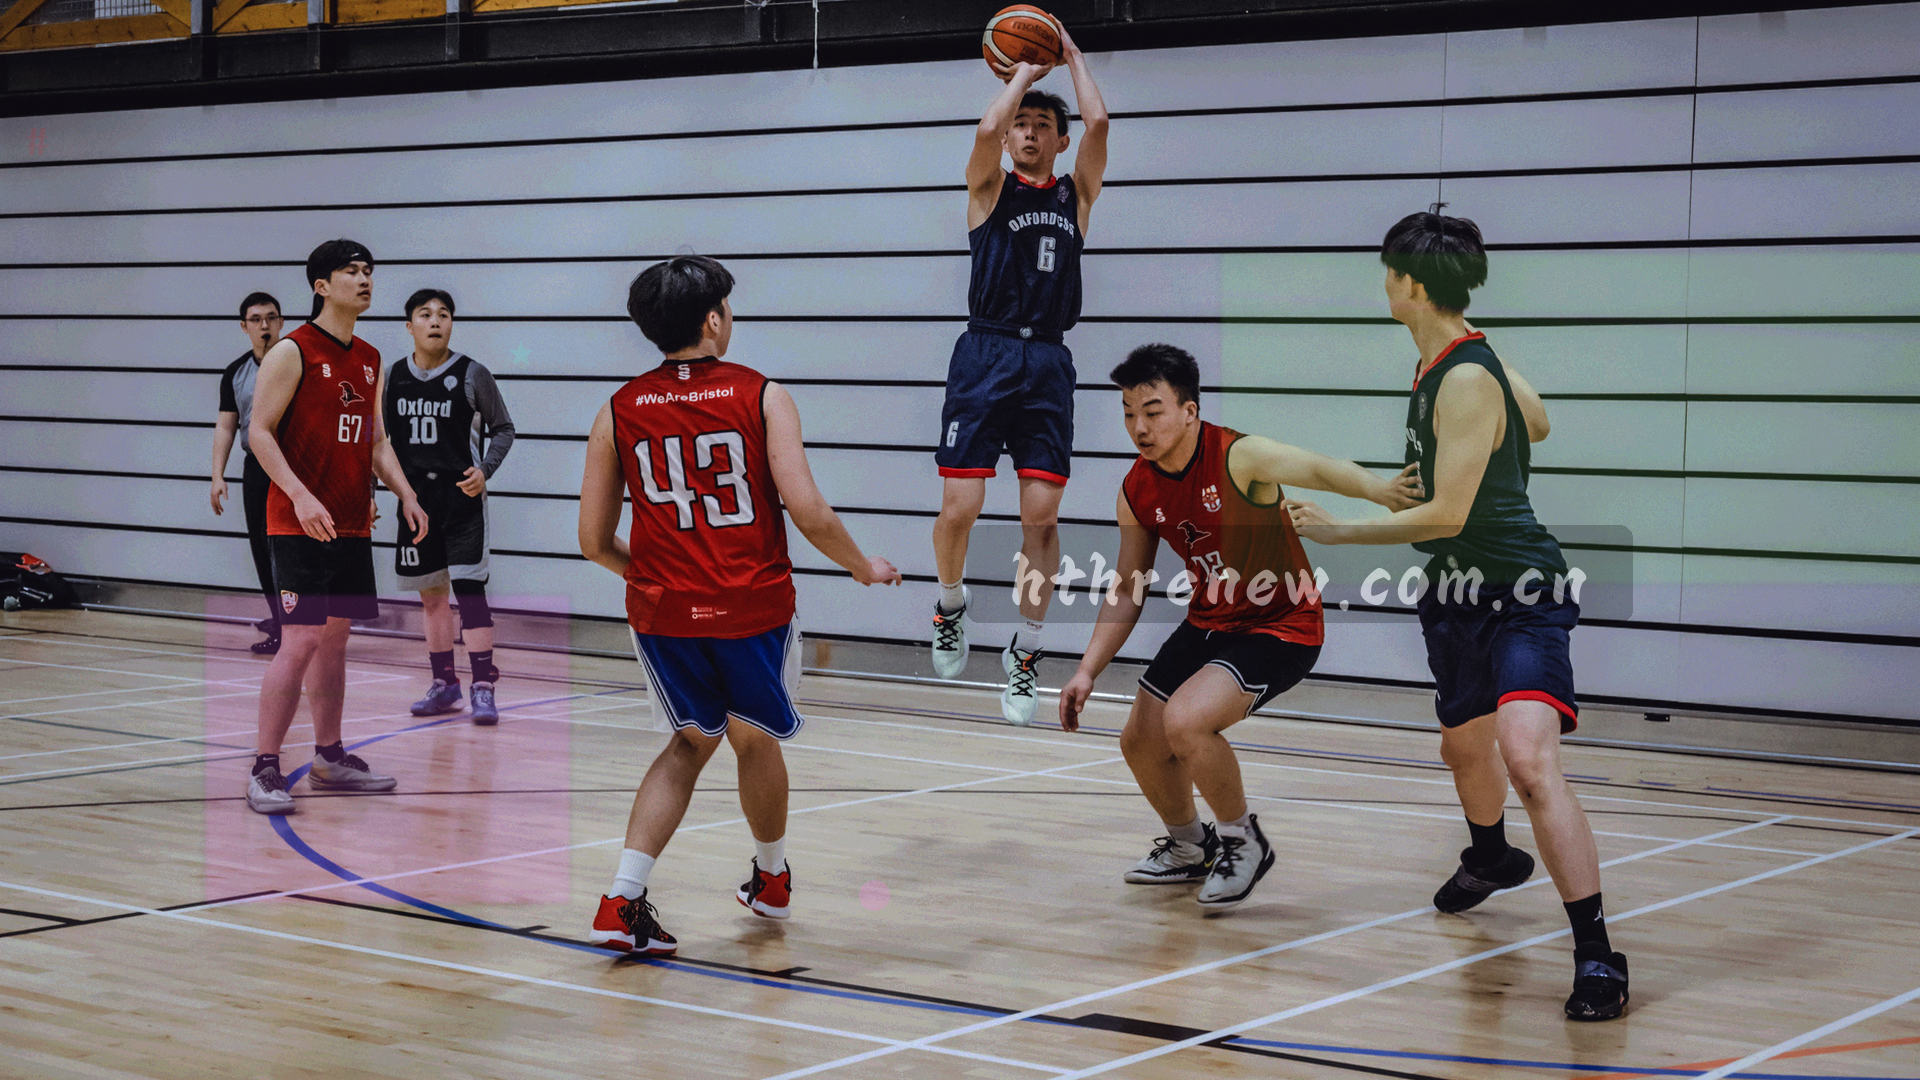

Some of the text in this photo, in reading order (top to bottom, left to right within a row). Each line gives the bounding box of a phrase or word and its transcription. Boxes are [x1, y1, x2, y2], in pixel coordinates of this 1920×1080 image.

[1008, 212, 1075, 239] OXFORDCSS
[1037, 236, 1056, 272] 6
[397, 398, 452, 418] Oxford
[338, 414, 362, 443] 67
[409, 417, 438, 444] 10
[946, 421, 959, 447] 6
[634, 430, 755, 531] 43
[401, 547, 420, 566] 10
